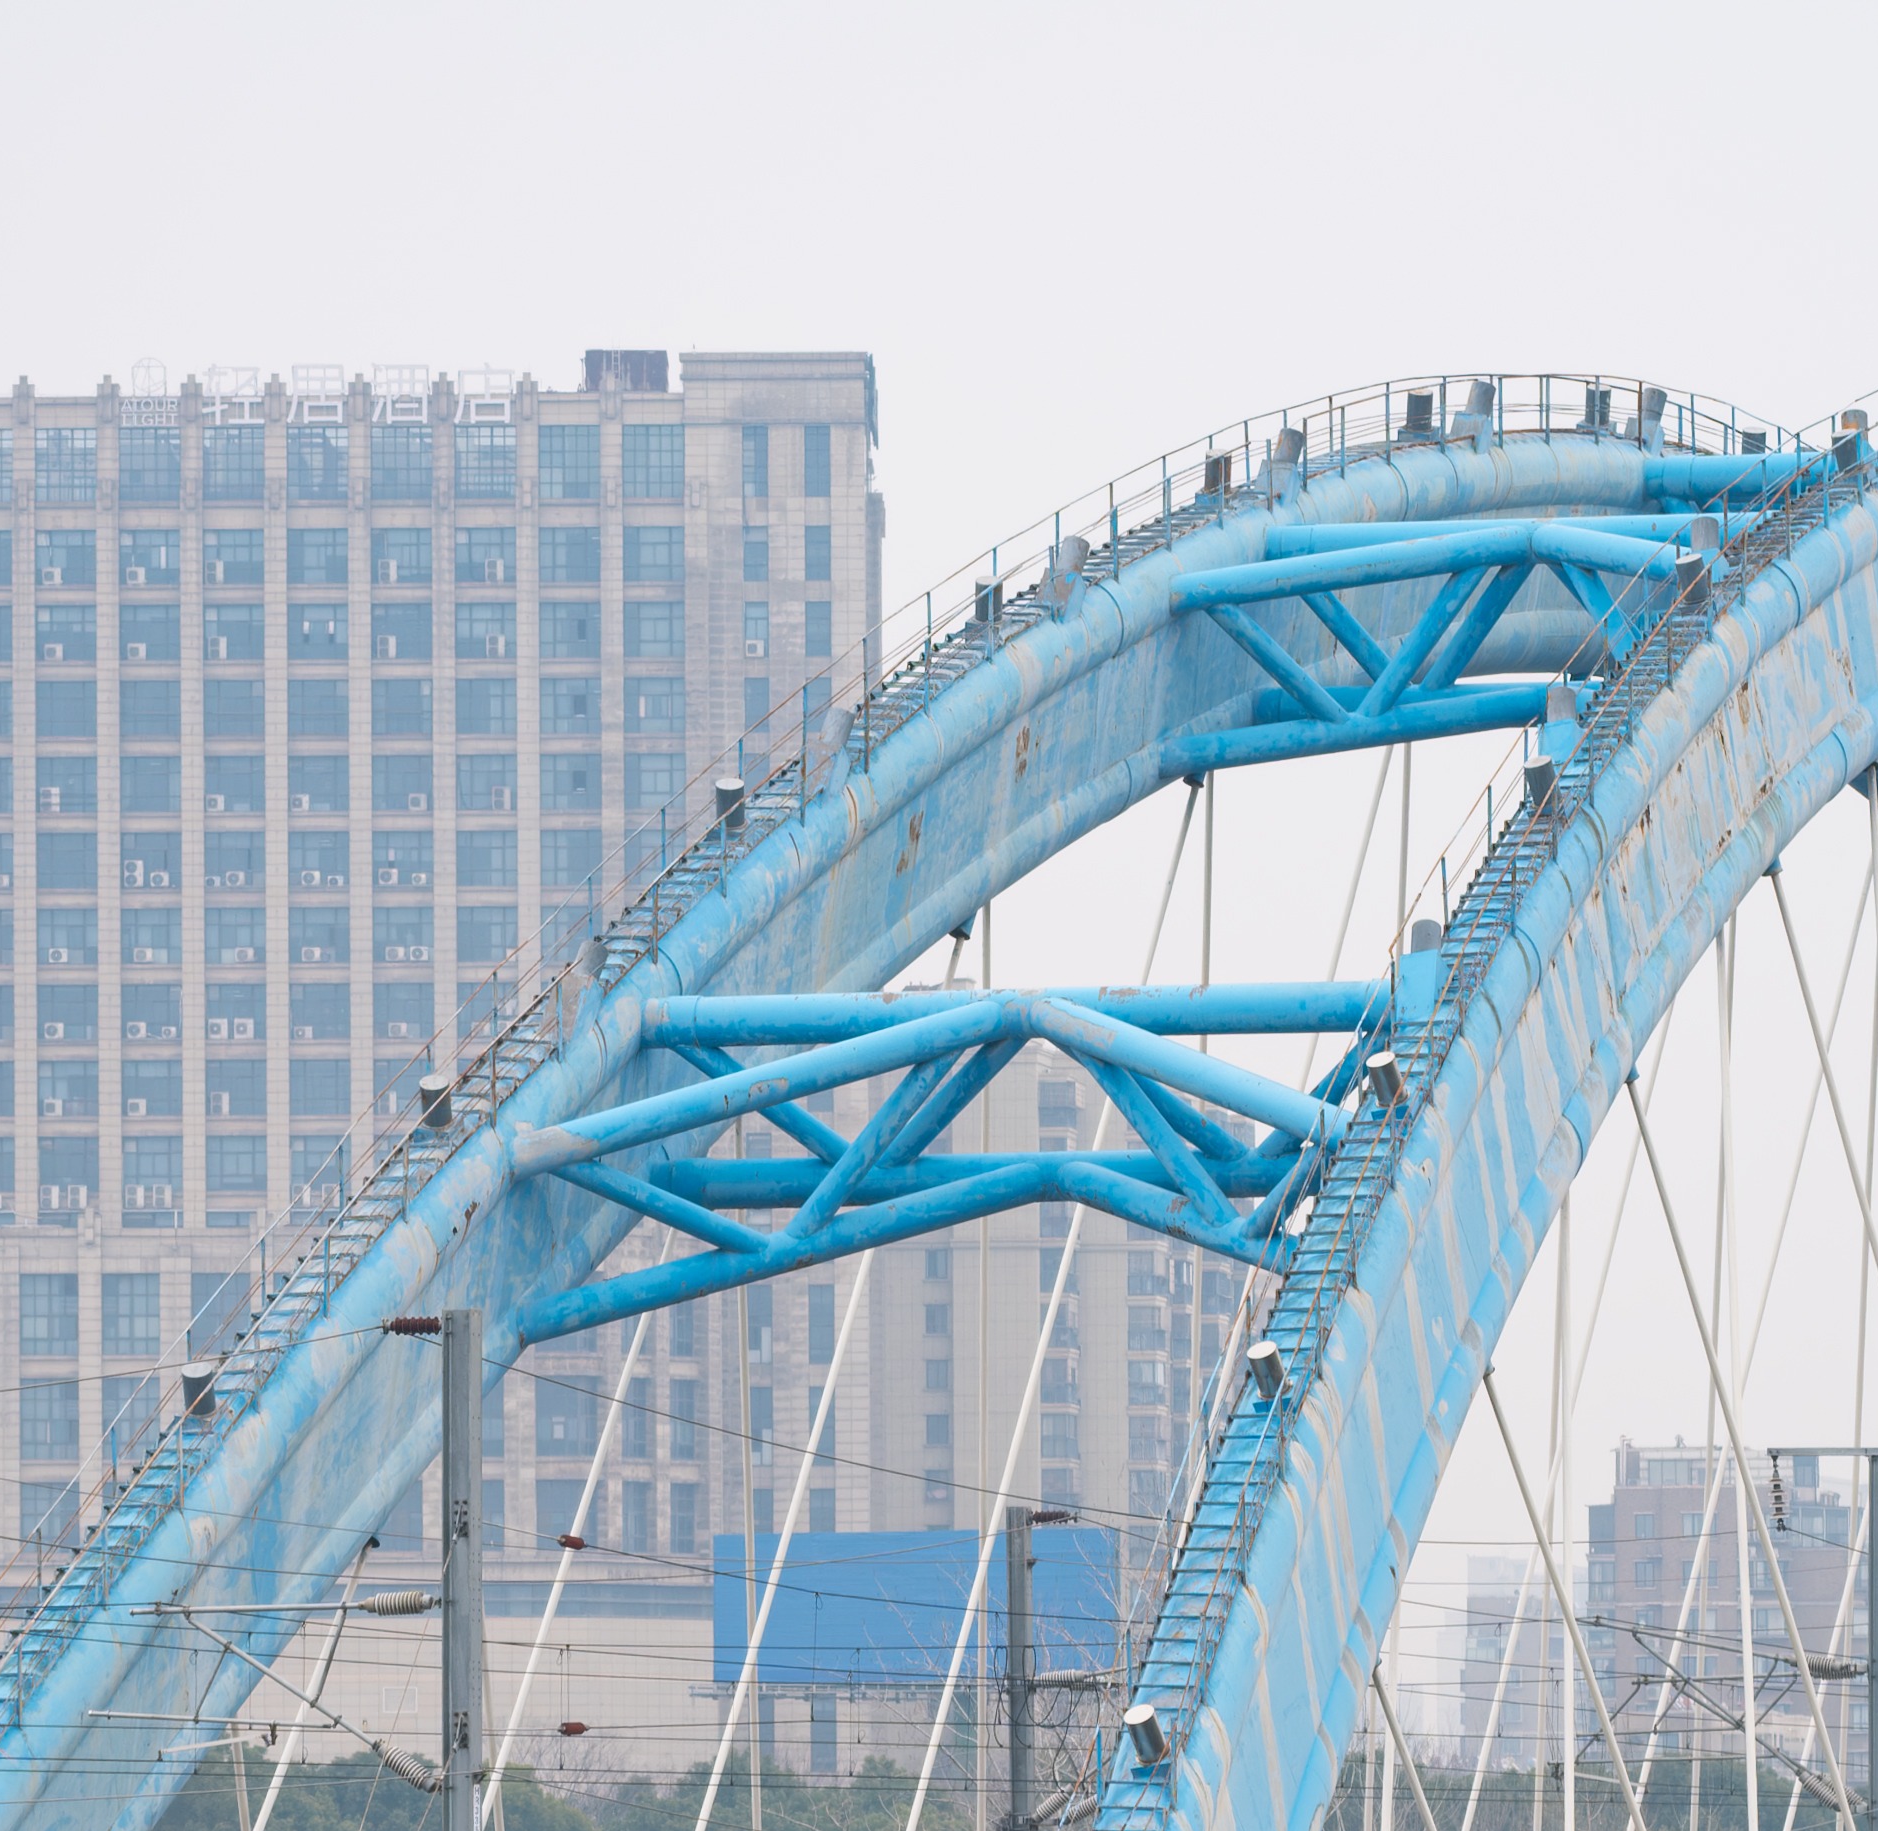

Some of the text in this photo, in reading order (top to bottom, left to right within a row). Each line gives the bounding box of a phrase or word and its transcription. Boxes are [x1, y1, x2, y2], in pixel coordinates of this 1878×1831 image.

[202, 362, 515, 425] 轻居酒店
[121, 399, 178, 412] ATOUR
[121, 413, 178, 425] LIGHT
